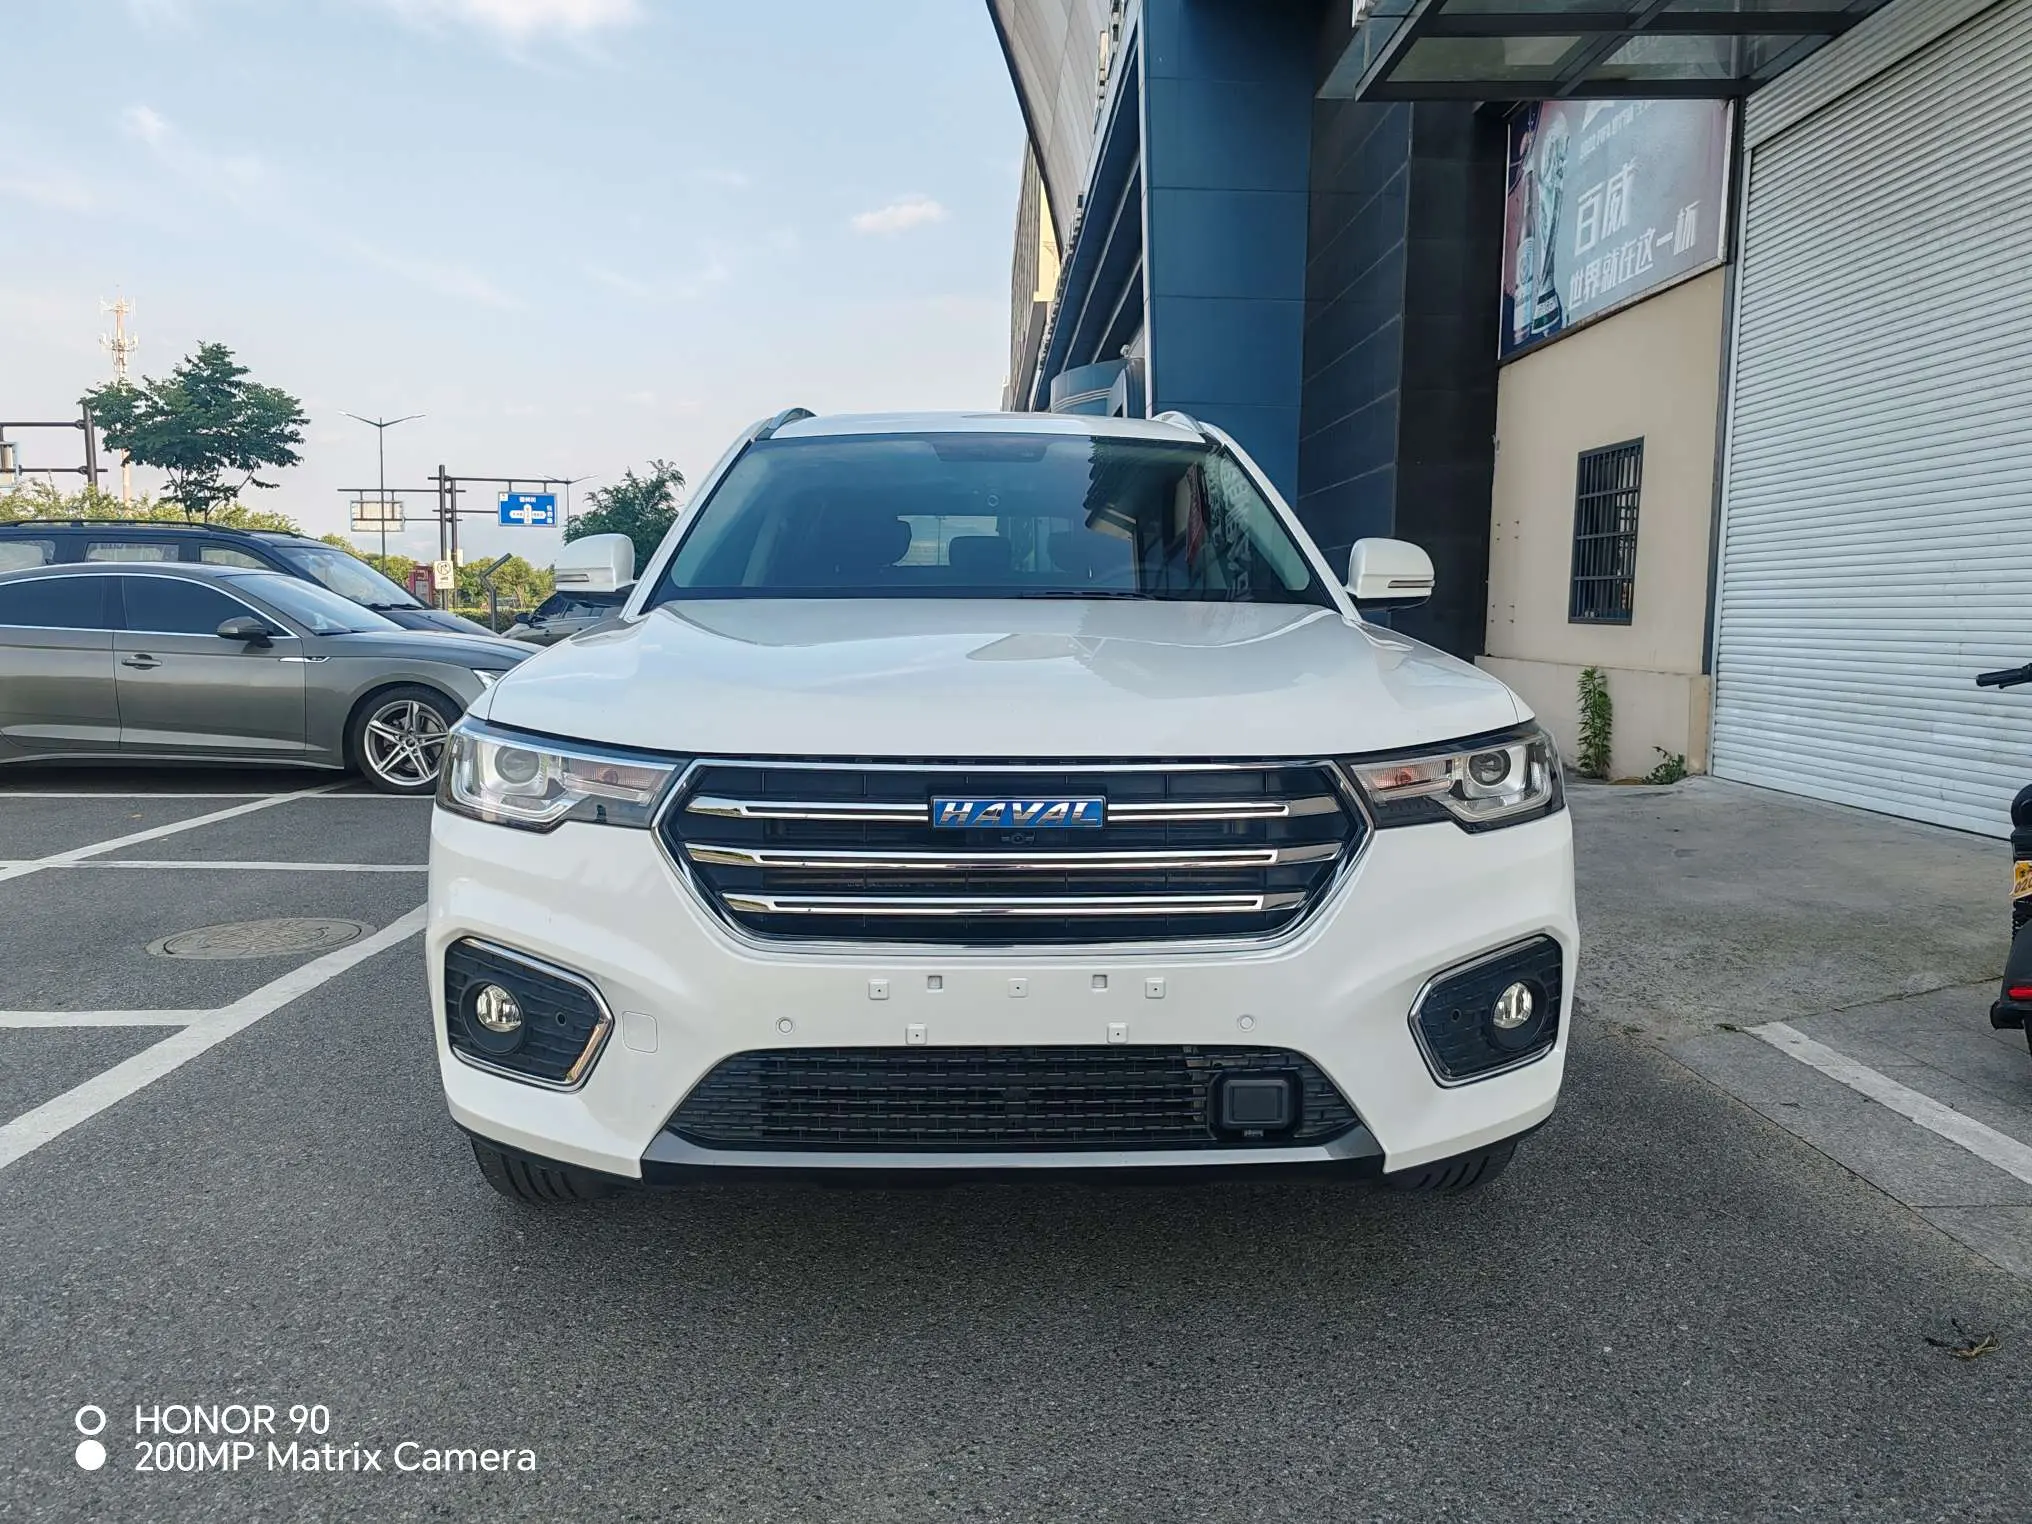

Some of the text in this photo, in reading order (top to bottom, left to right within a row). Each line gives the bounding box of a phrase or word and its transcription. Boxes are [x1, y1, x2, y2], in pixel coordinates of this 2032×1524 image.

[1568, 200, 1700, 311] 世界就在这一杯
[940, 802, 1099, 825] HAVAL
